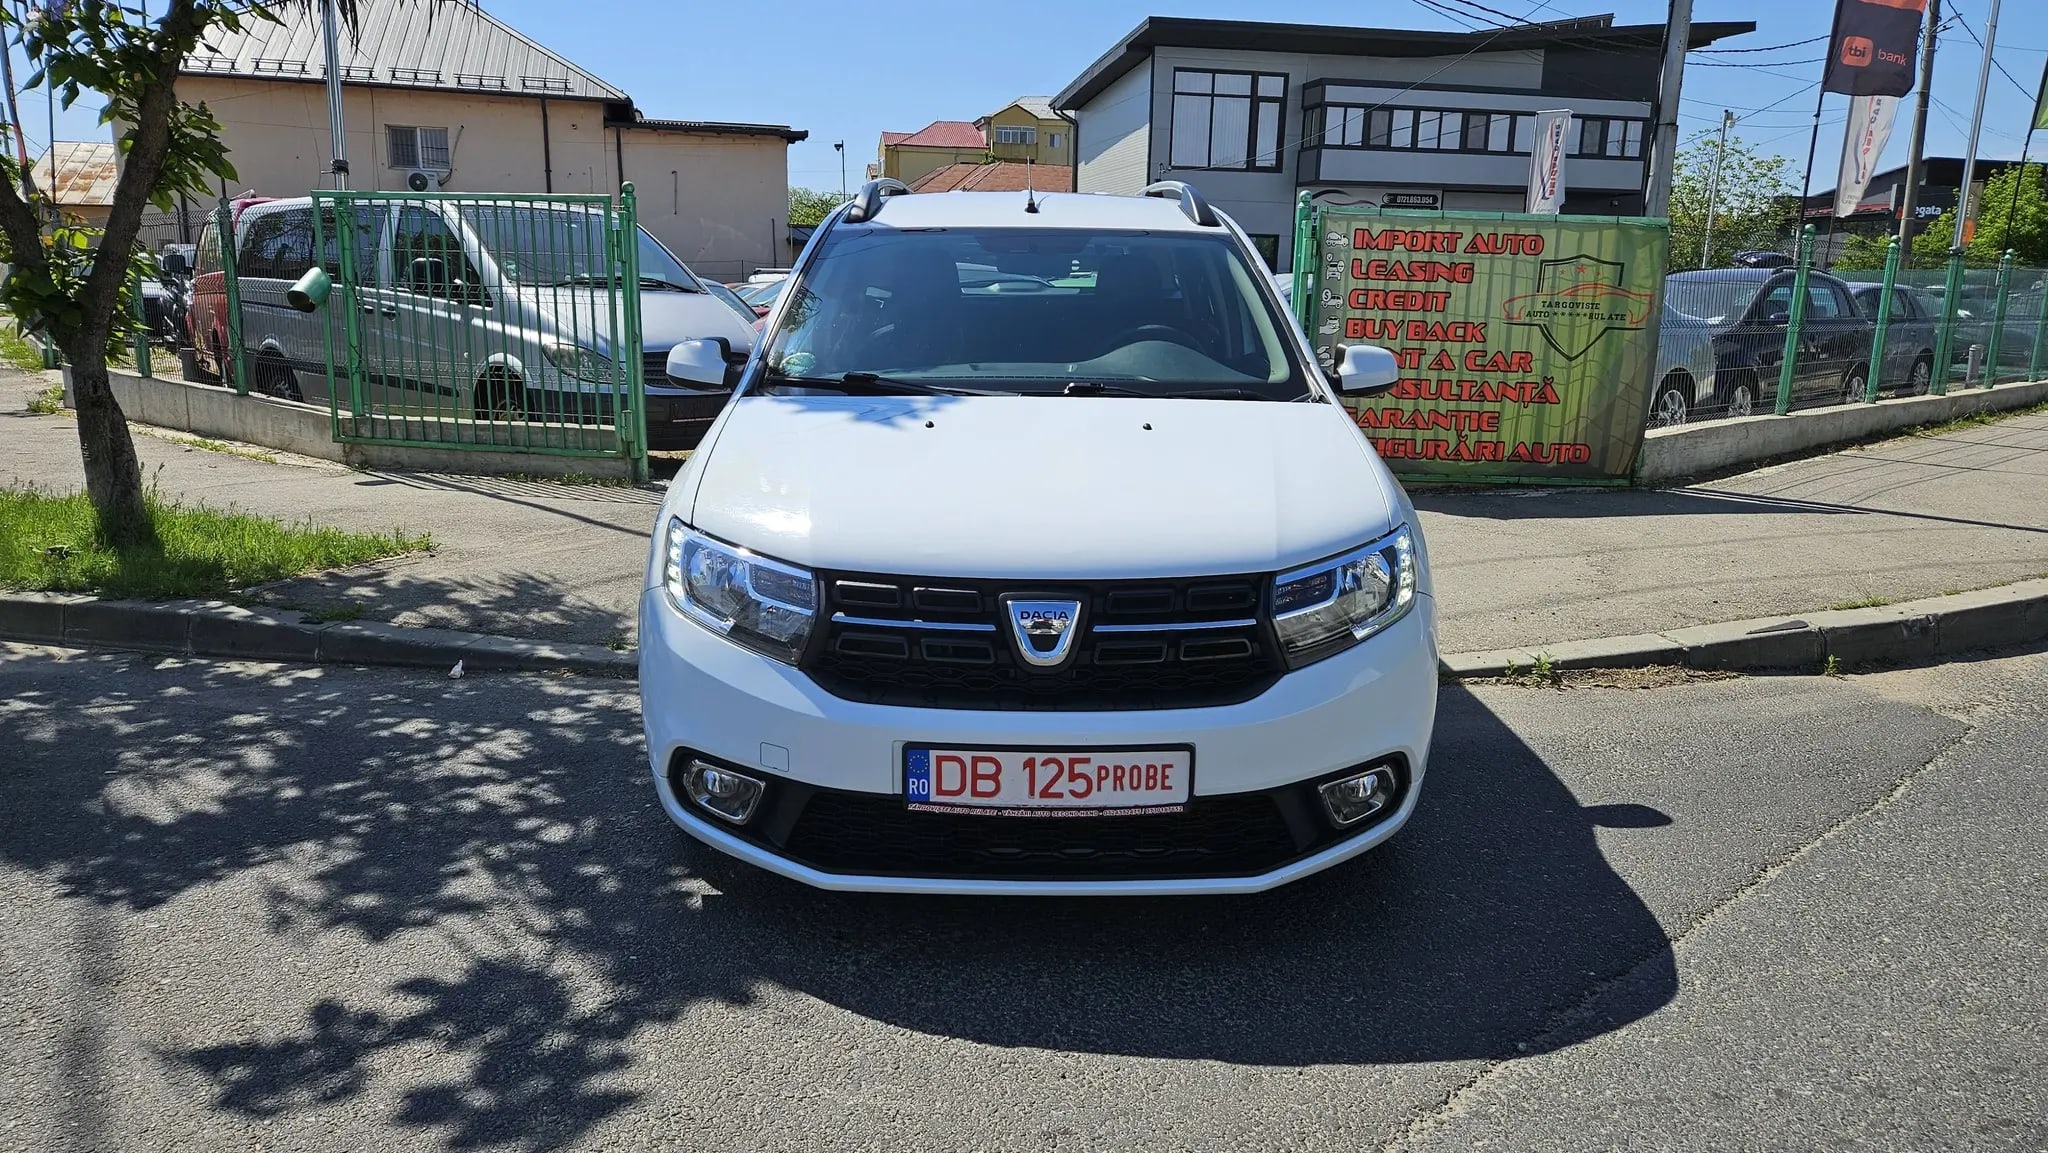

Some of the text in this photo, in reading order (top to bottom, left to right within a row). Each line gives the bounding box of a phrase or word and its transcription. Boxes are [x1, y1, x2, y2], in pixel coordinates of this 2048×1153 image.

[1848, 46, 1908, 66] tbi bank
[1353, 228, 1544, 256] IMPORT AUTO
[1351, 258, 1475, 284] LEASING
[1348, 289, 1452, 312] CREDIT
[1541, 300, 1600, 310] TARGOVISTE
[1525, 310, 1550, 318] AUTO
[1344, 319, 1487, 343] BUY BACK
[1428, 350, 1456, 371] A
[1464, 350, 1533, 374] CAR
[1506, 441, 1591, 465] AUTO
[1020, 610, 1069, 620] DACIA
[908, 754, 1174, 800] RO DB 125 PROBE
